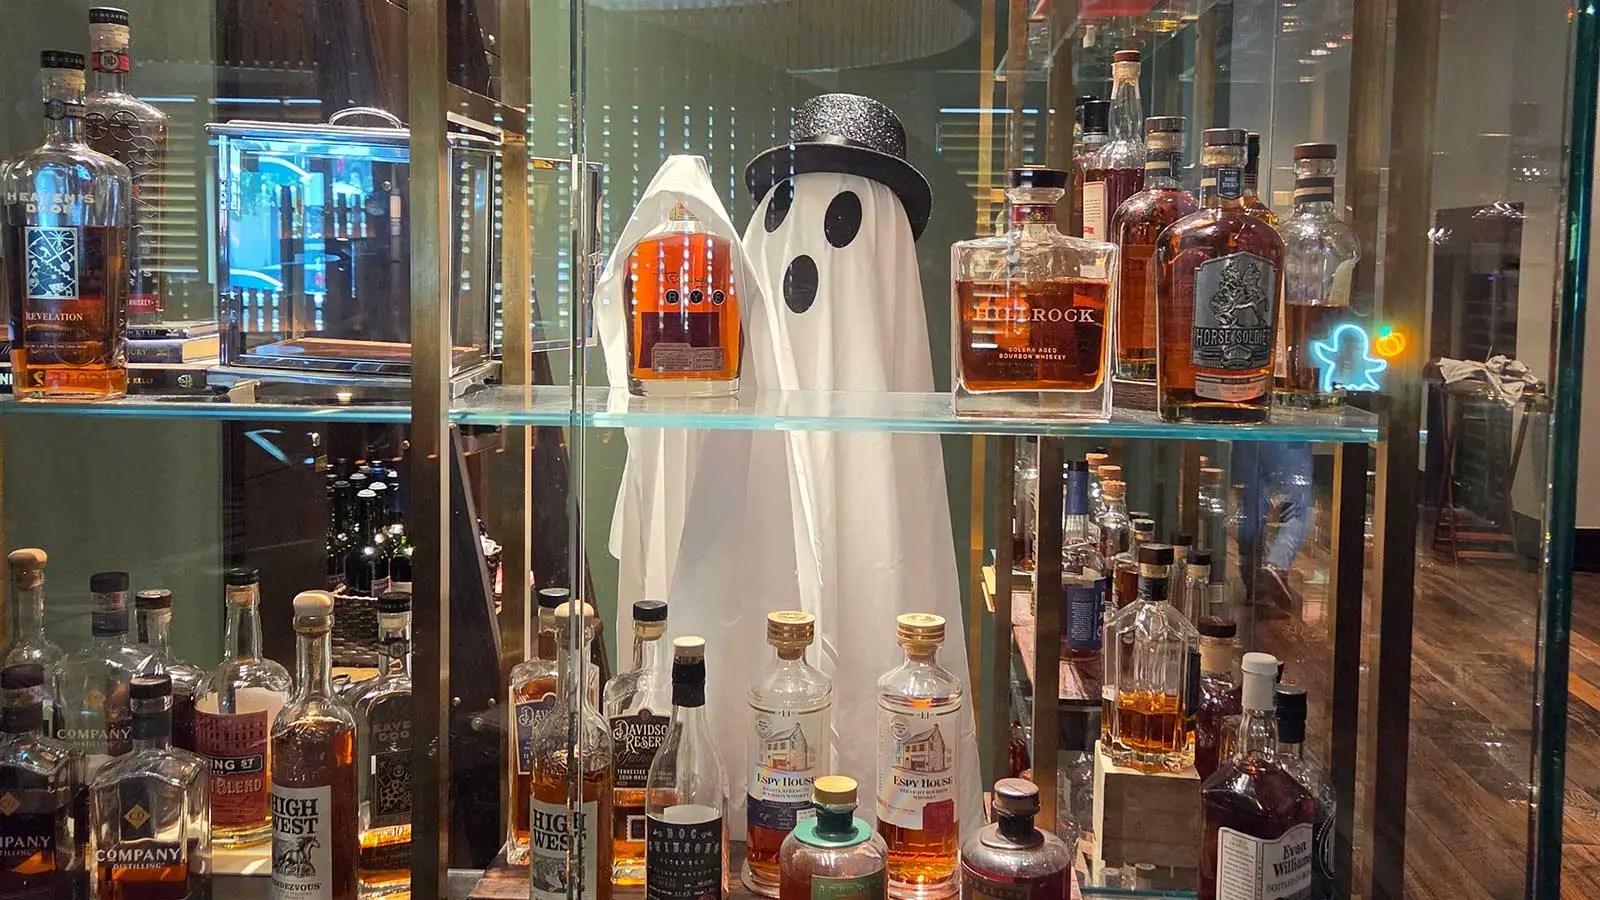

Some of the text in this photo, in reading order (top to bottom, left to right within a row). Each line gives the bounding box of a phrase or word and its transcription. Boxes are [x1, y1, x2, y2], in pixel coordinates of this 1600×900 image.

[25, 312, 83, 321] REVELATION
[973, 305, 1095, 322] HILLROCK
[1196, 329, 1231, 345] HORSE
[57, 726, 131, 741] COMPANY
[757, 773, 780, 787] ESPY
[893, 775, 953, 788] ESPY HOUSE
[95, 847, 181, 862] COMPANY
